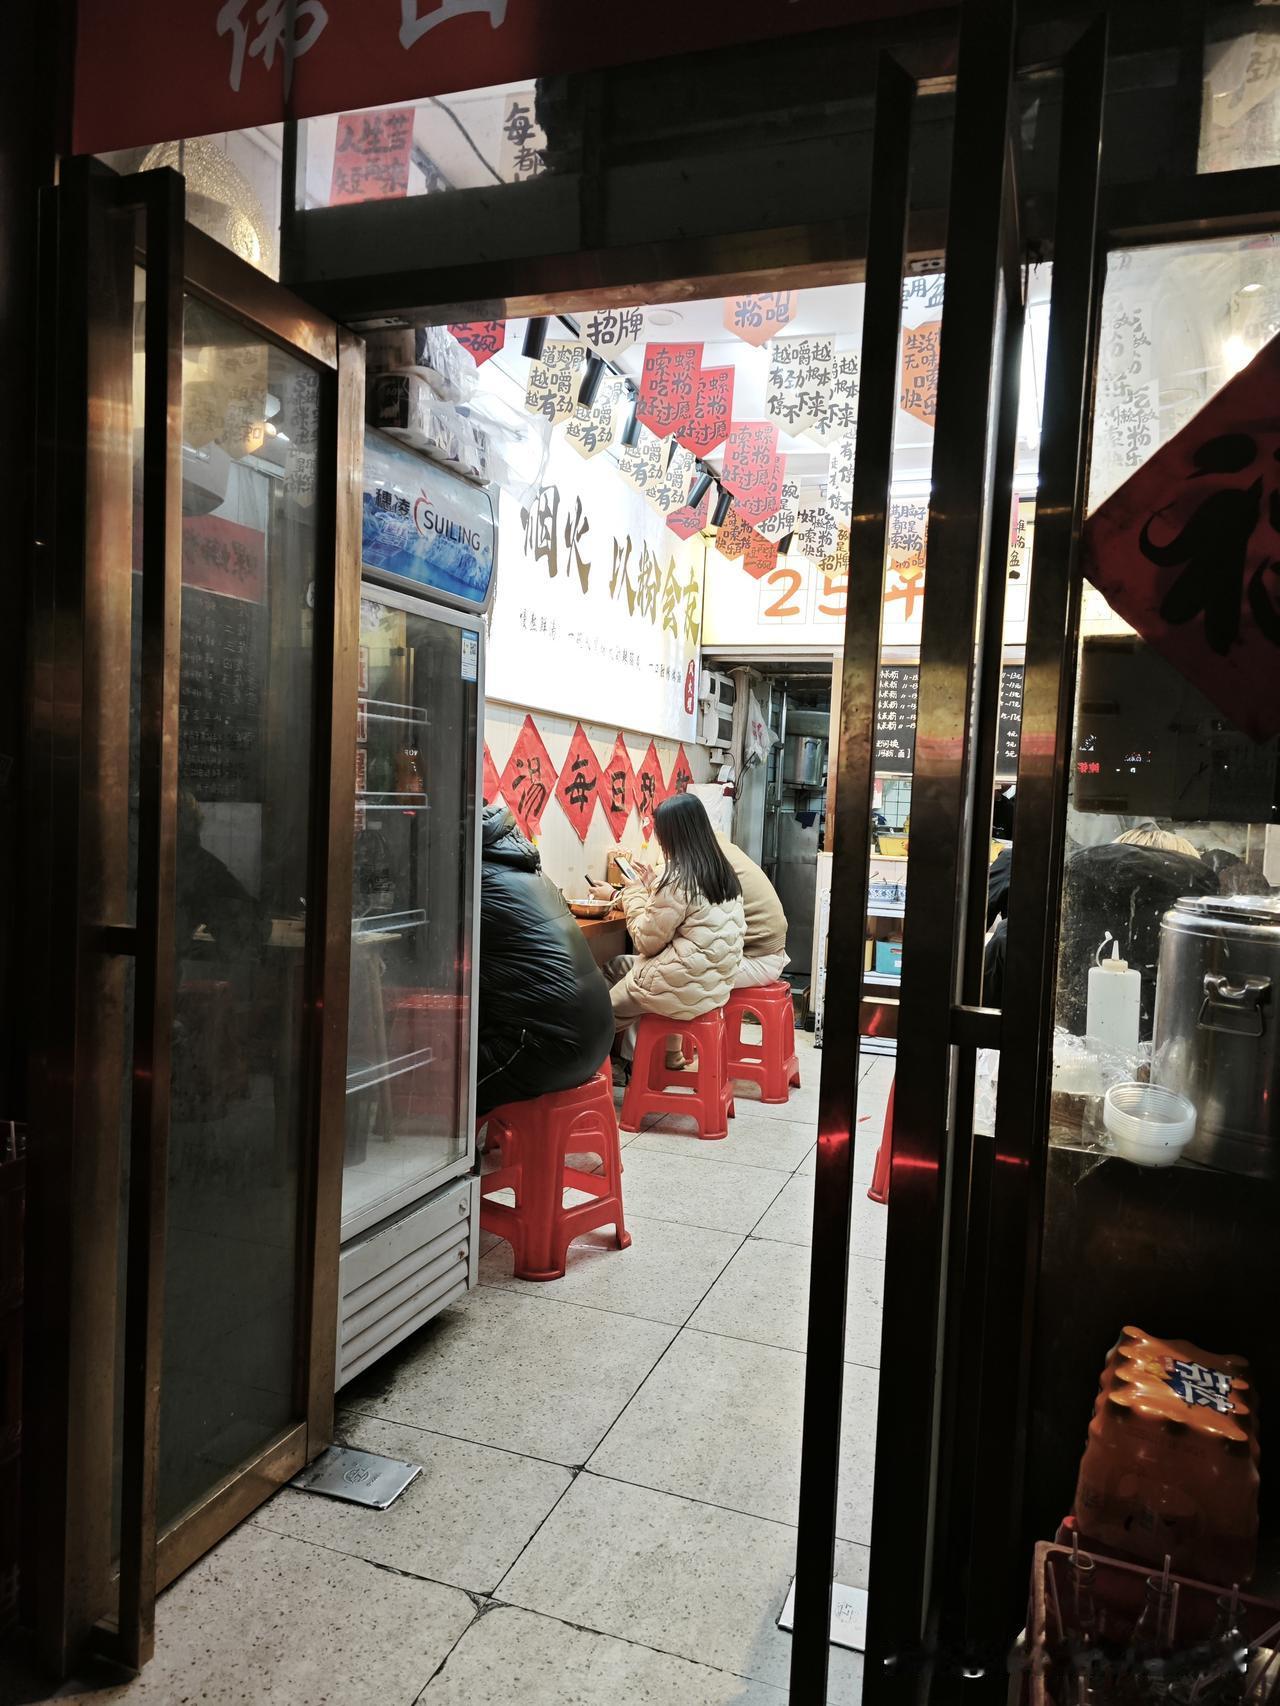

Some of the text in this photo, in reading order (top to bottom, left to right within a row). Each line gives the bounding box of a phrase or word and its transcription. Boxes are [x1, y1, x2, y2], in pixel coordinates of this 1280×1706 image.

[587, 308, 643, 347] 招牌
[772, 340, 831, 365] 越嚼越
[530, 366, 572, 395] 越嚼
[649, 371, 692, 397] 吃粉
[525, 389, 574, 422] 越有劲
[768, 391, 827, 424] 停不下来
[566, 421, 613, 452] 越有劲
[676, 419, 729, 446] 好过瘾
[619, 459, 663, 487] 越有劲
[645, 484, 685, 512] 越有劲
[424, 510, 481, 551] SUILING
[758, 511, 795, 534] 招牌
